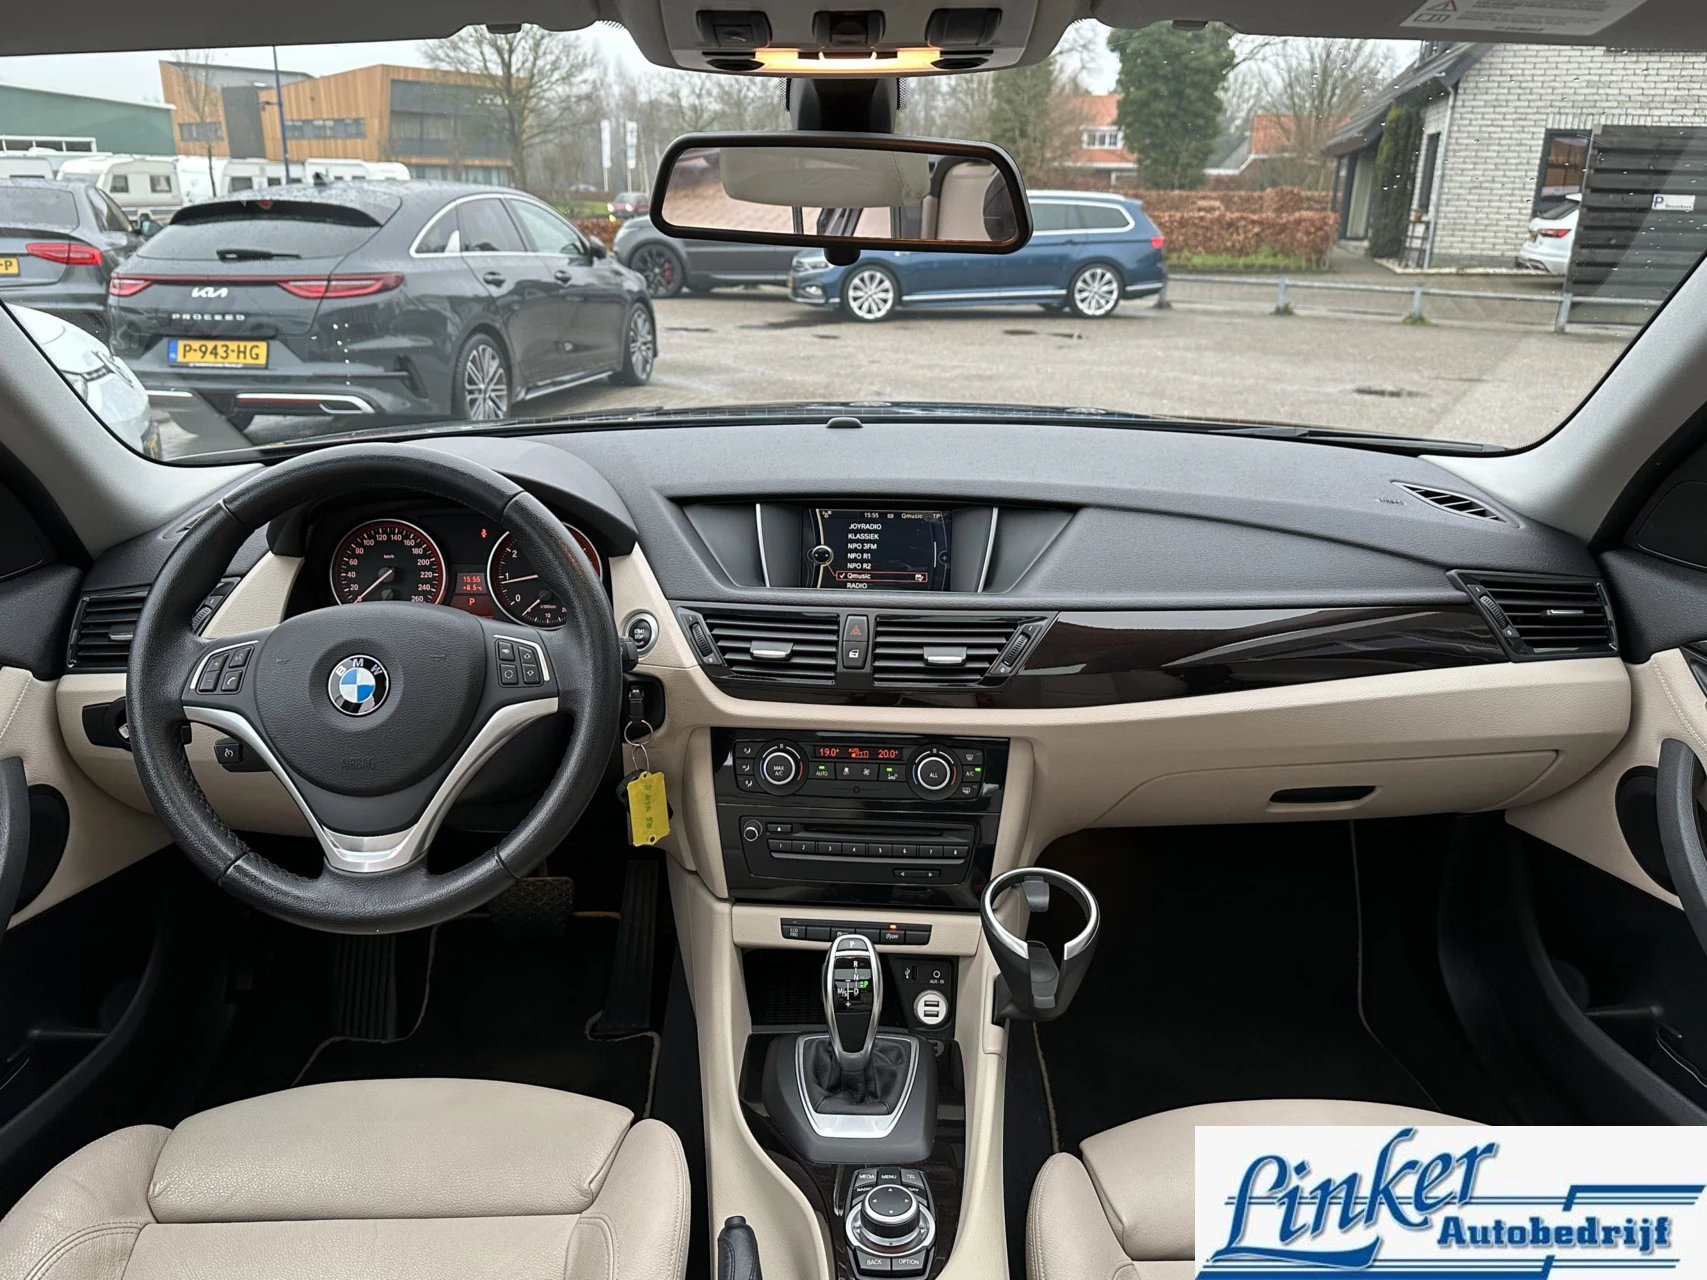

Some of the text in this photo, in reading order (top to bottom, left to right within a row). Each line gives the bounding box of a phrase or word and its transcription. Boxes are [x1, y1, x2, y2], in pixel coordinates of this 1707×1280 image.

[1654, 196, 1664, 208] P
[191, 287, 228, 298] KIA
[183, 344, 260, 360] P-943-HG
[512, 550, 518, 558] 2
[505, 572, 509, 580] 1
[469, 597, 475, 606] P
[515, 594, 521, 602] 0
[335, 658, 383, 677] BMW
[341, 758, 376, 771] AIRBAG
[849, 940, 854, 948] P
[853, 960, 858, 968] R
